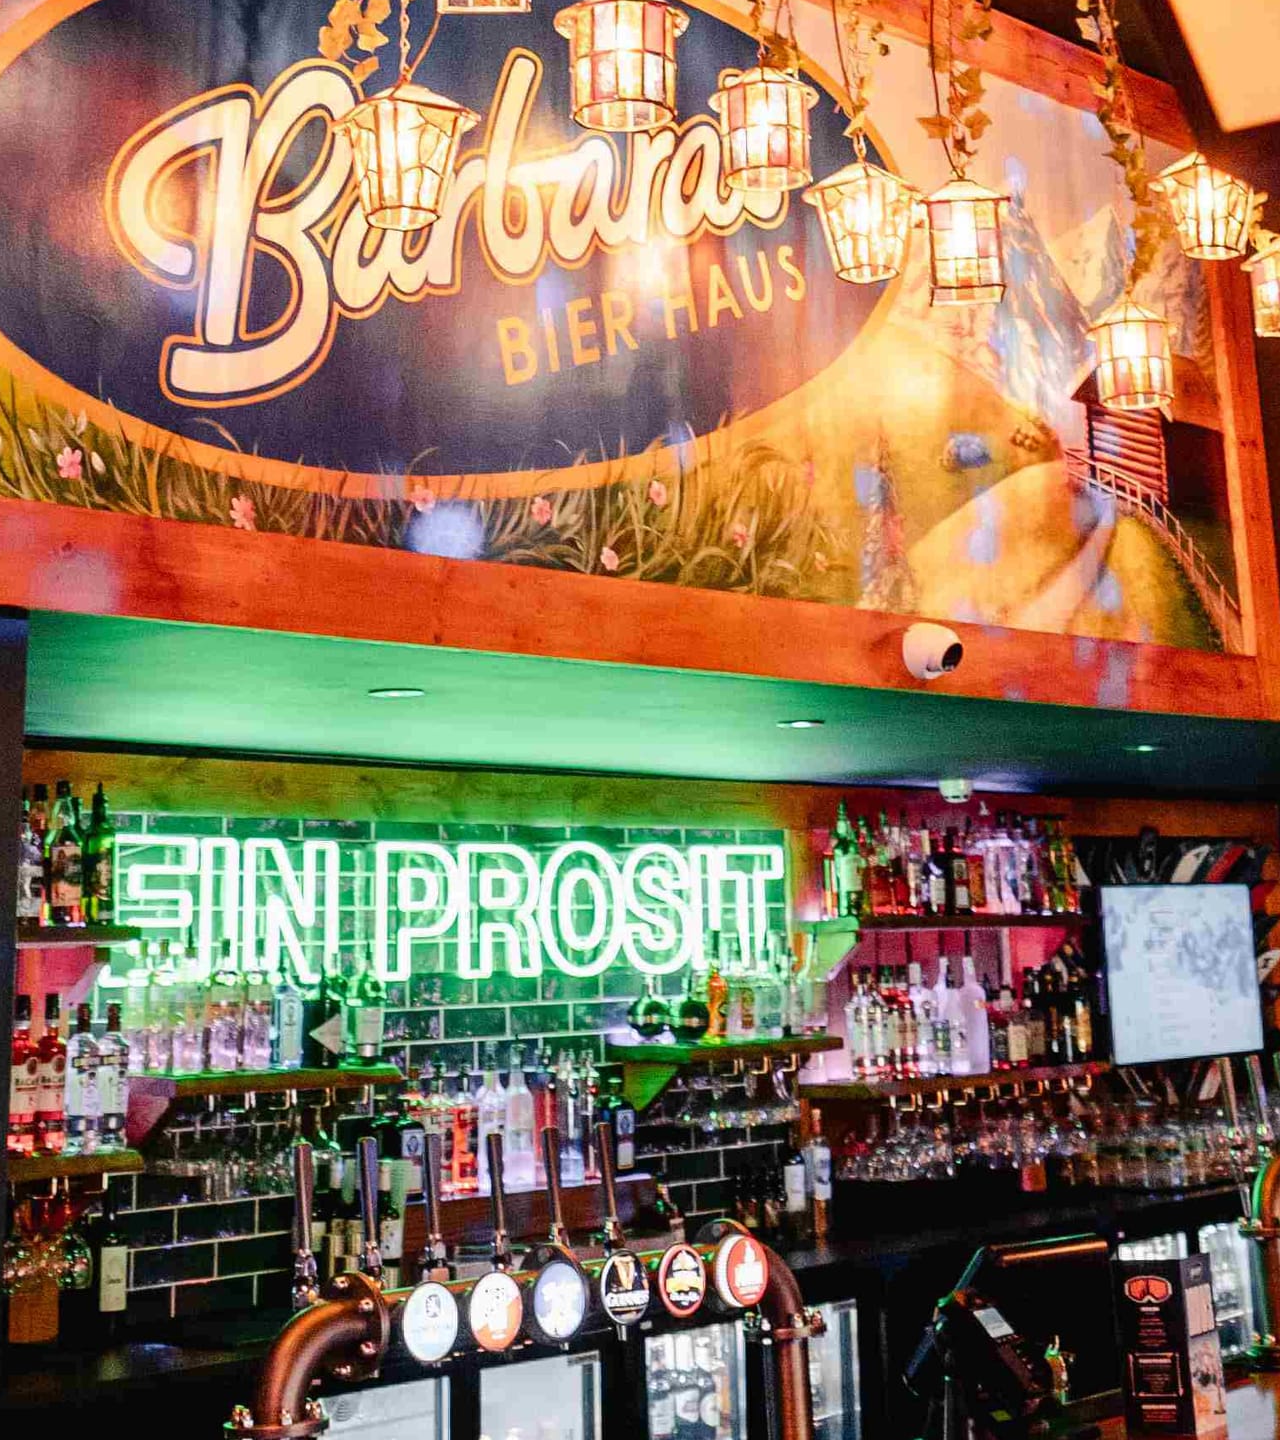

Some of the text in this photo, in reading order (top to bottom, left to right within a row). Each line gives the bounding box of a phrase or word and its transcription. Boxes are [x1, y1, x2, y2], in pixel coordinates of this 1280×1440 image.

[105, 47, 789, 409] Barbara
[497, 246, 808, 386] BIER HAUS
[374, 842, 785, 981] PROSIT
